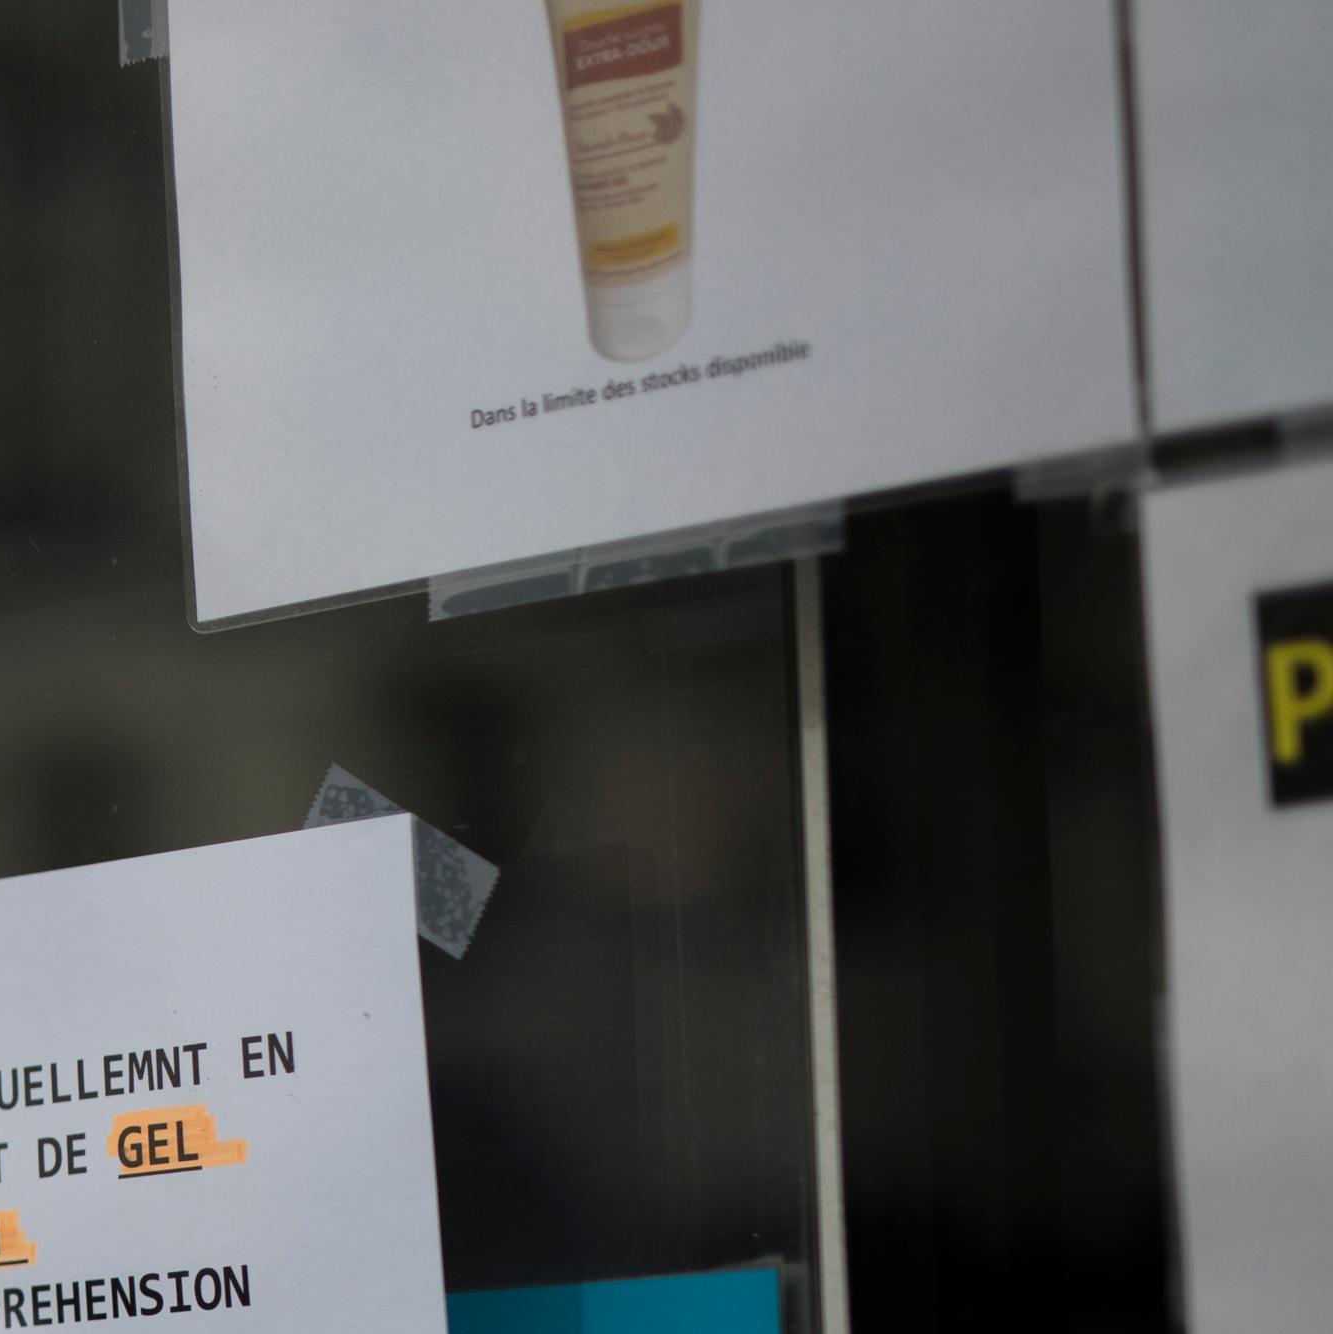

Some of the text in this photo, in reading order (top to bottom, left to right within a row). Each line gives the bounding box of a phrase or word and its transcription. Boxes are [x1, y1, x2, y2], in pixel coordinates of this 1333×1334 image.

[470, 338, 813, 430] Dans la limite des stocks disponible
[241, 1031, 295, 1079] EN
[37, 1132, 88, 1179] DE
[117, 1120, 203, 1180] GEL
